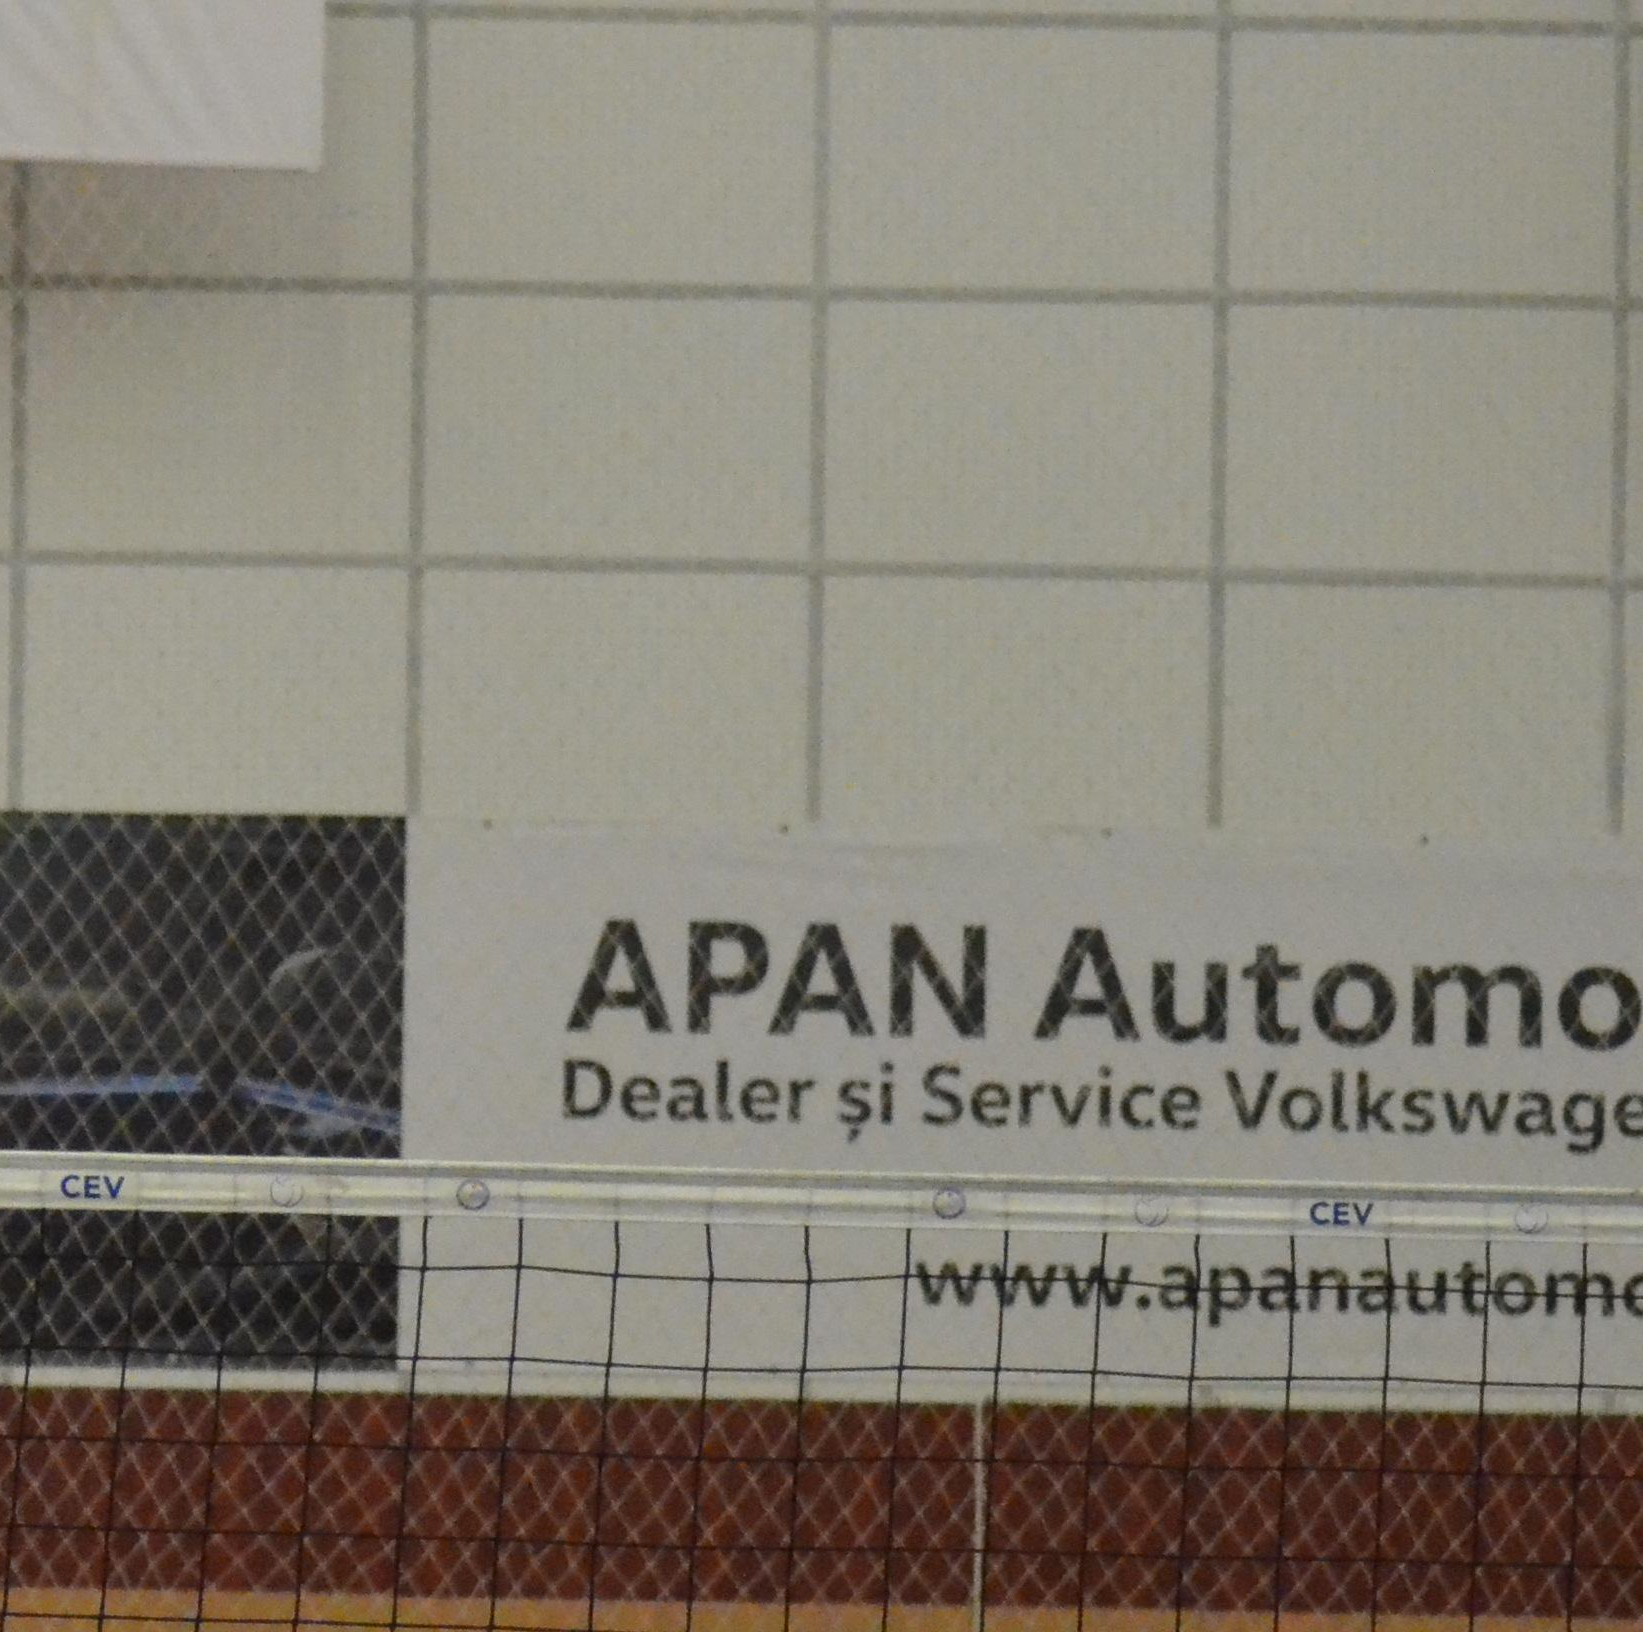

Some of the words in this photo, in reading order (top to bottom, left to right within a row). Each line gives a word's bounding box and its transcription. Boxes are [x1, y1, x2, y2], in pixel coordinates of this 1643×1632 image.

[565, 918, 989, 1042] APAN
[1033, 924, 1643, 1051] Automo
[561, 1058, 816, 1126] Dealer
[836, 1062, 893, 1141] și
[921, 1064, 1201, 1134] Service
[60, 1174, 125, 1200] CEV
[1309, 1202, 1374, 1227] CEV
